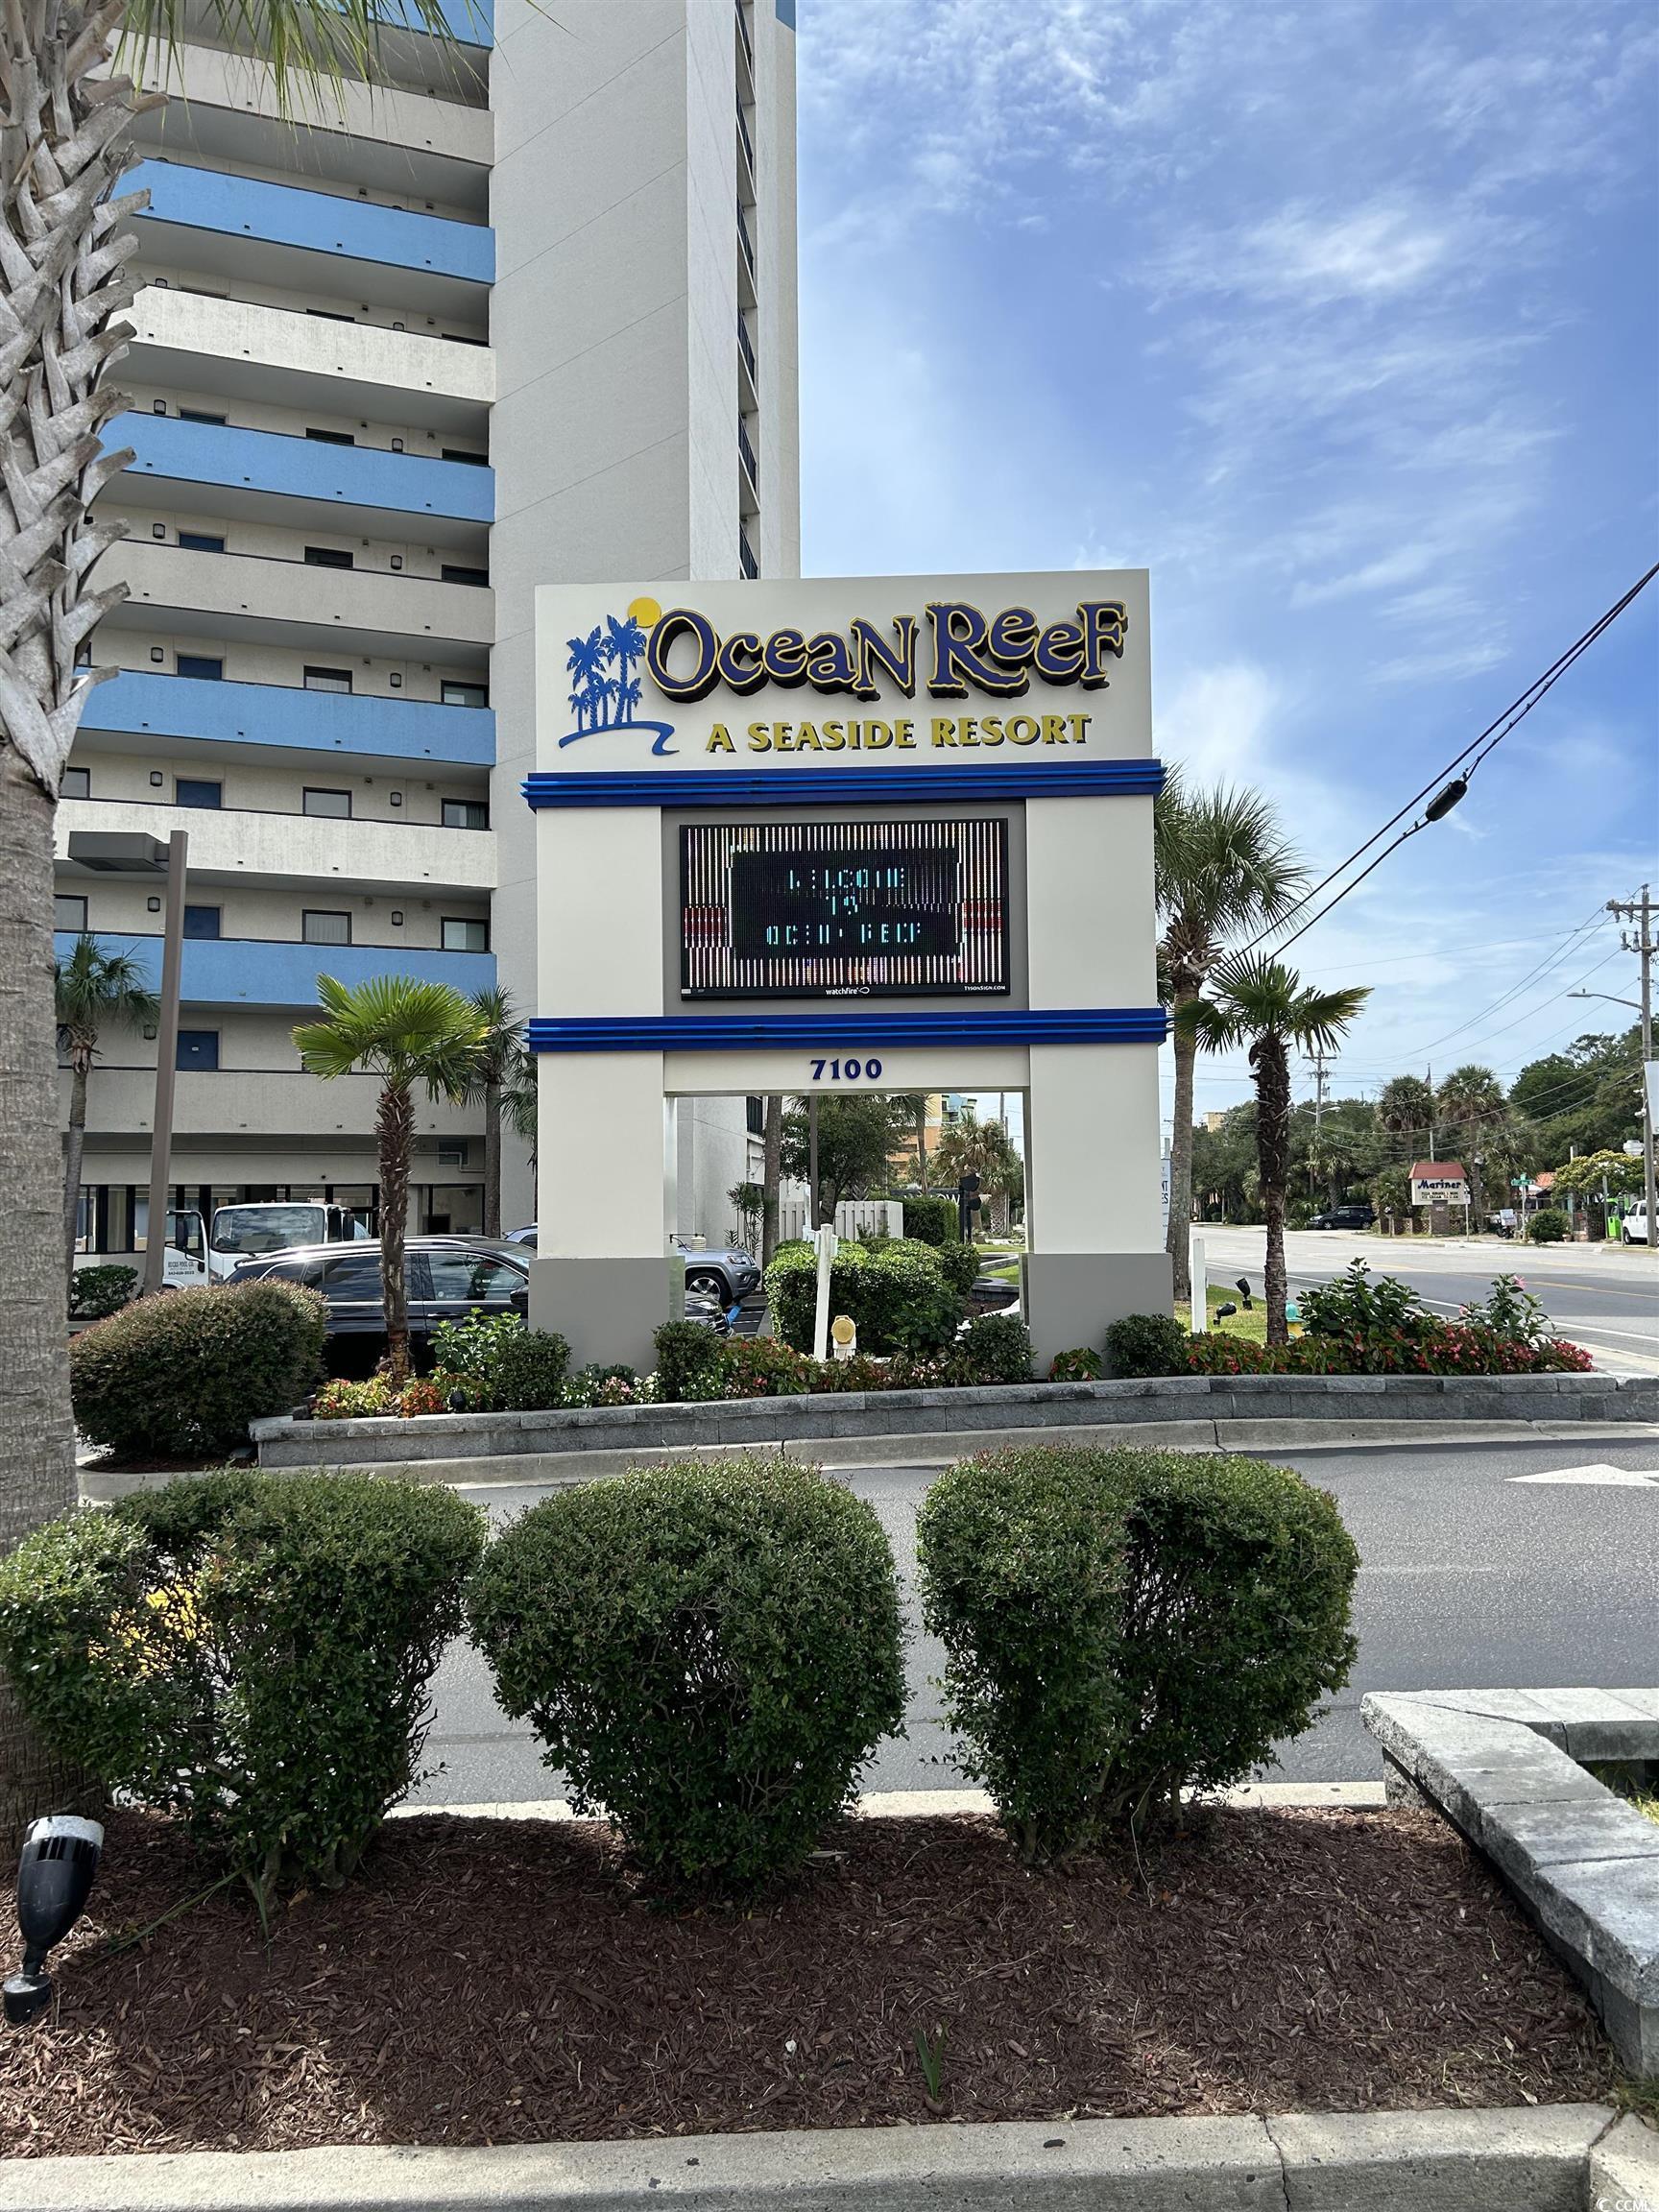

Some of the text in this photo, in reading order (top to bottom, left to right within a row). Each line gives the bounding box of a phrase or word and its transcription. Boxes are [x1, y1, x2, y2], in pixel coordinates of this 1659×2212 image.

[706, 714, 1093, 753] A SEASIDE RESORT
[826, 987, 858, 996] watchfire
[809, 1058, 882, 1080] 7100
[1418, 1179, 1461, 1190] Mariner
